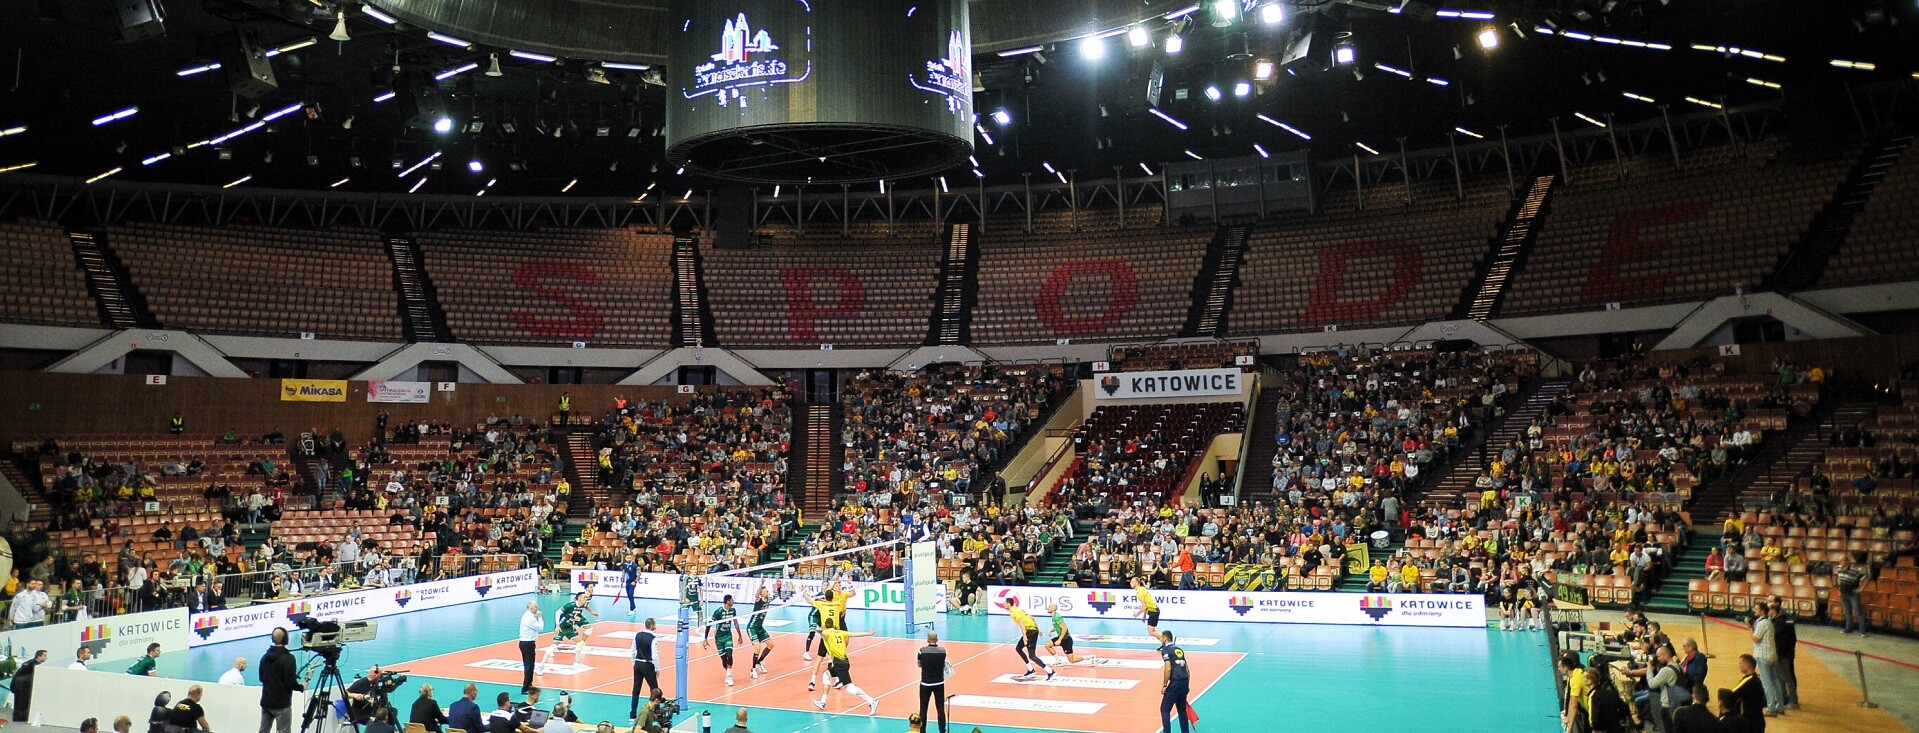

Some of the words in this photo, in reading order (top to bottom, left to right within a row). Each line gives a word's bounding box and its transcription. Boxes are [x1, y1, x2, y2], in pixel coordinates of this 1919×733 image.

[1132, 374, 1236, 393] KATOWICE
[496, 573, 533, 584] KATOWICE
[316, 597, 366, 611] KATOWICE
[1123, 596, 1186, 604] KAWICE
[1400, 600, 1472, 609] KATOWICE
[225, 610, 276, 625] KATOWICE
[119, 619, 180, 636] KATOWICE
[130, 637, 154, 645] odmiany
